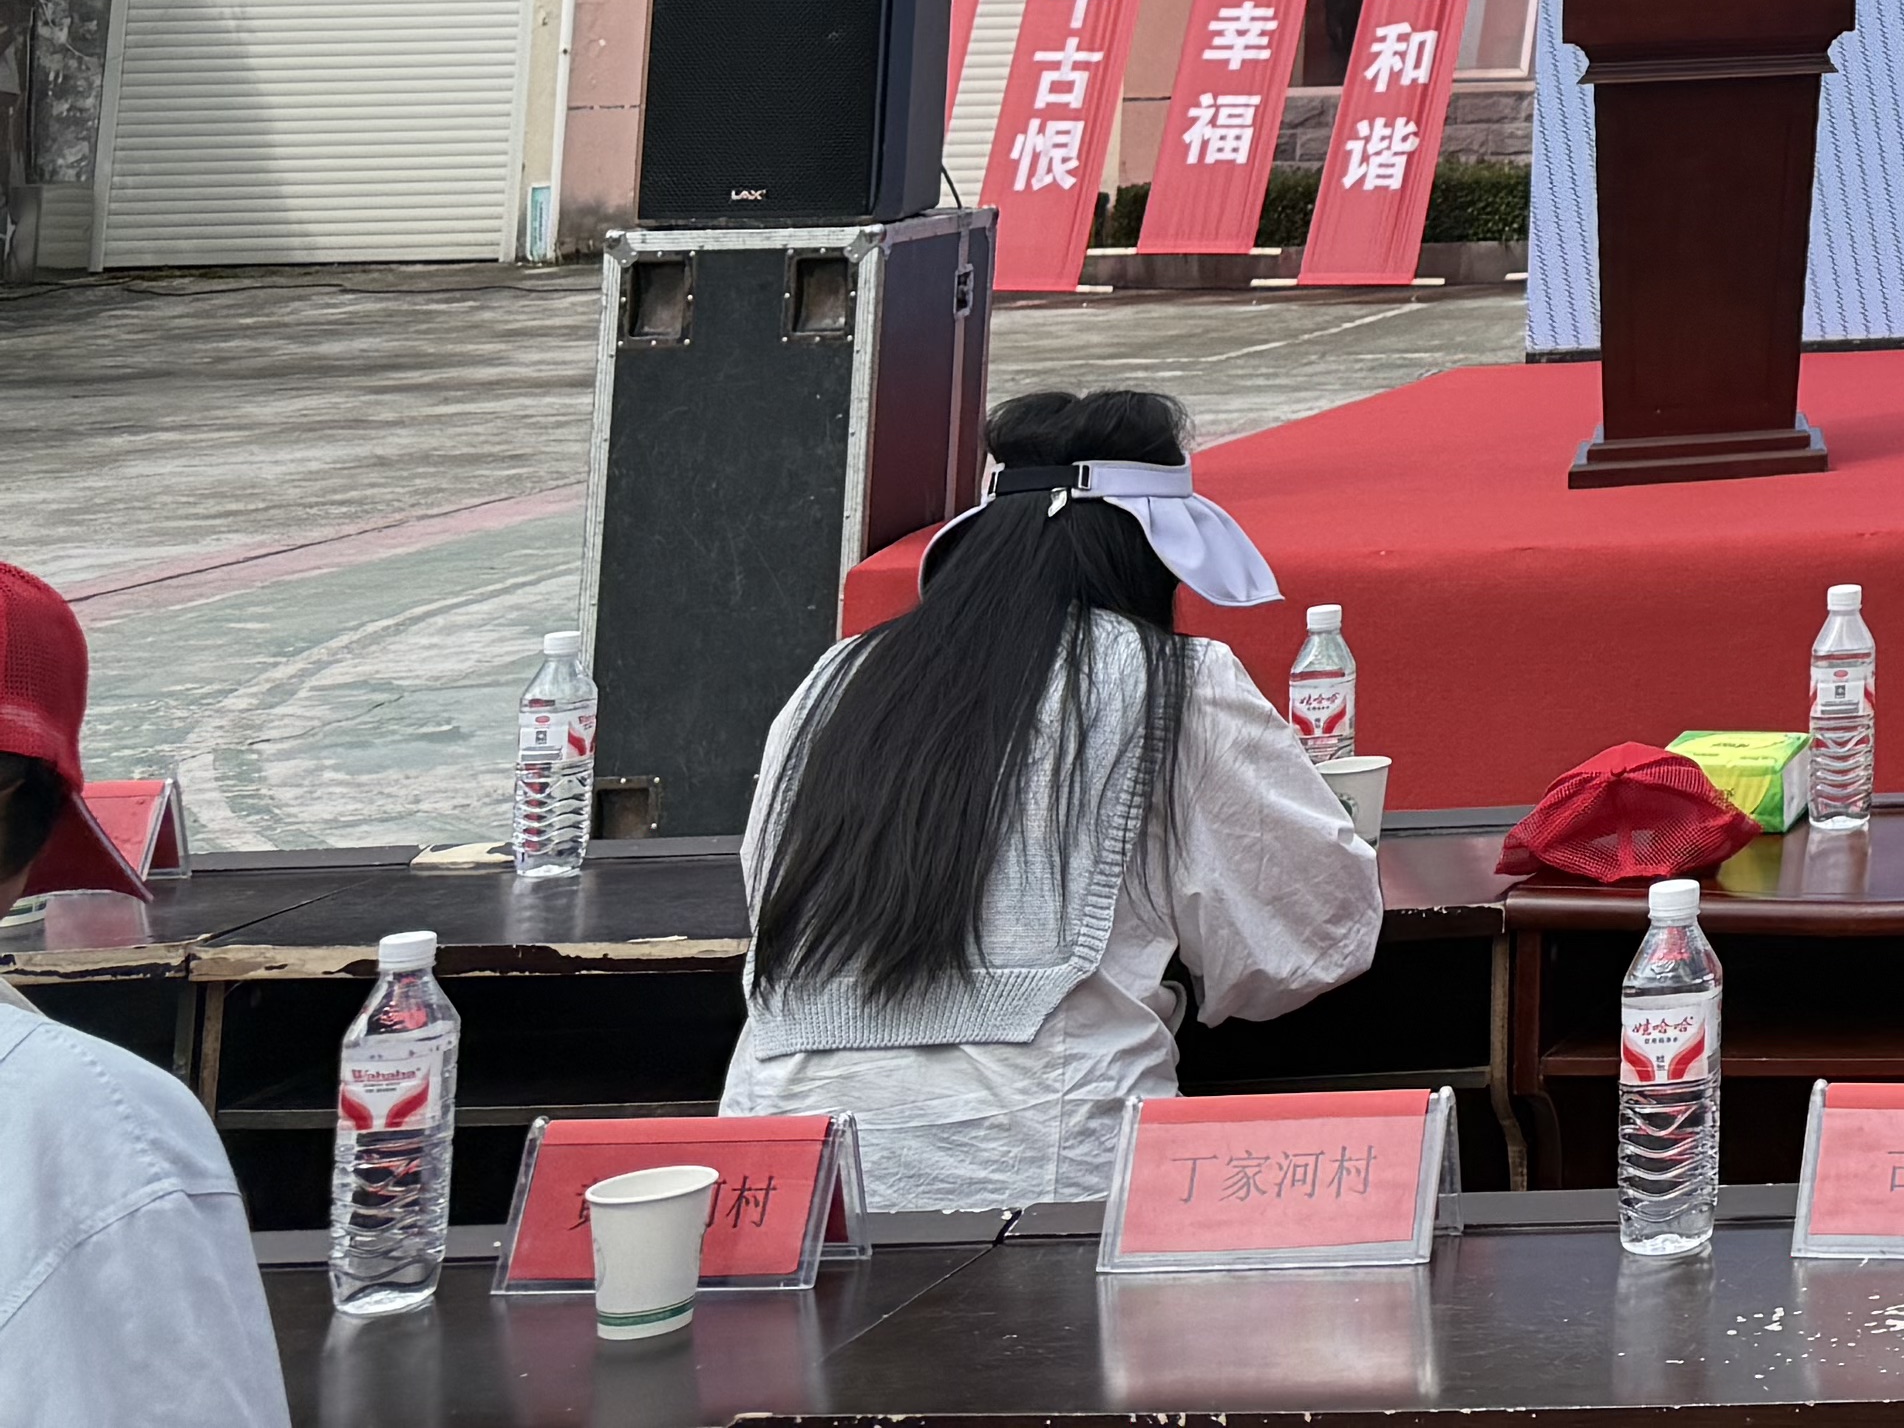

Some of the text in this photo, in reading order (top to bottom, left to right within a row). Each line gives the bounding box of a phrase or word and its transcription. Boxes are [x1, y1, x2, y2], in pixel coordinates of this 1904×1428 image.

[731, 189, 764, 200] LAX
[1632, 1016, 1693, 1036] 娃哈哈
[1171, 1144, 1378, 1204] 丁家河村
